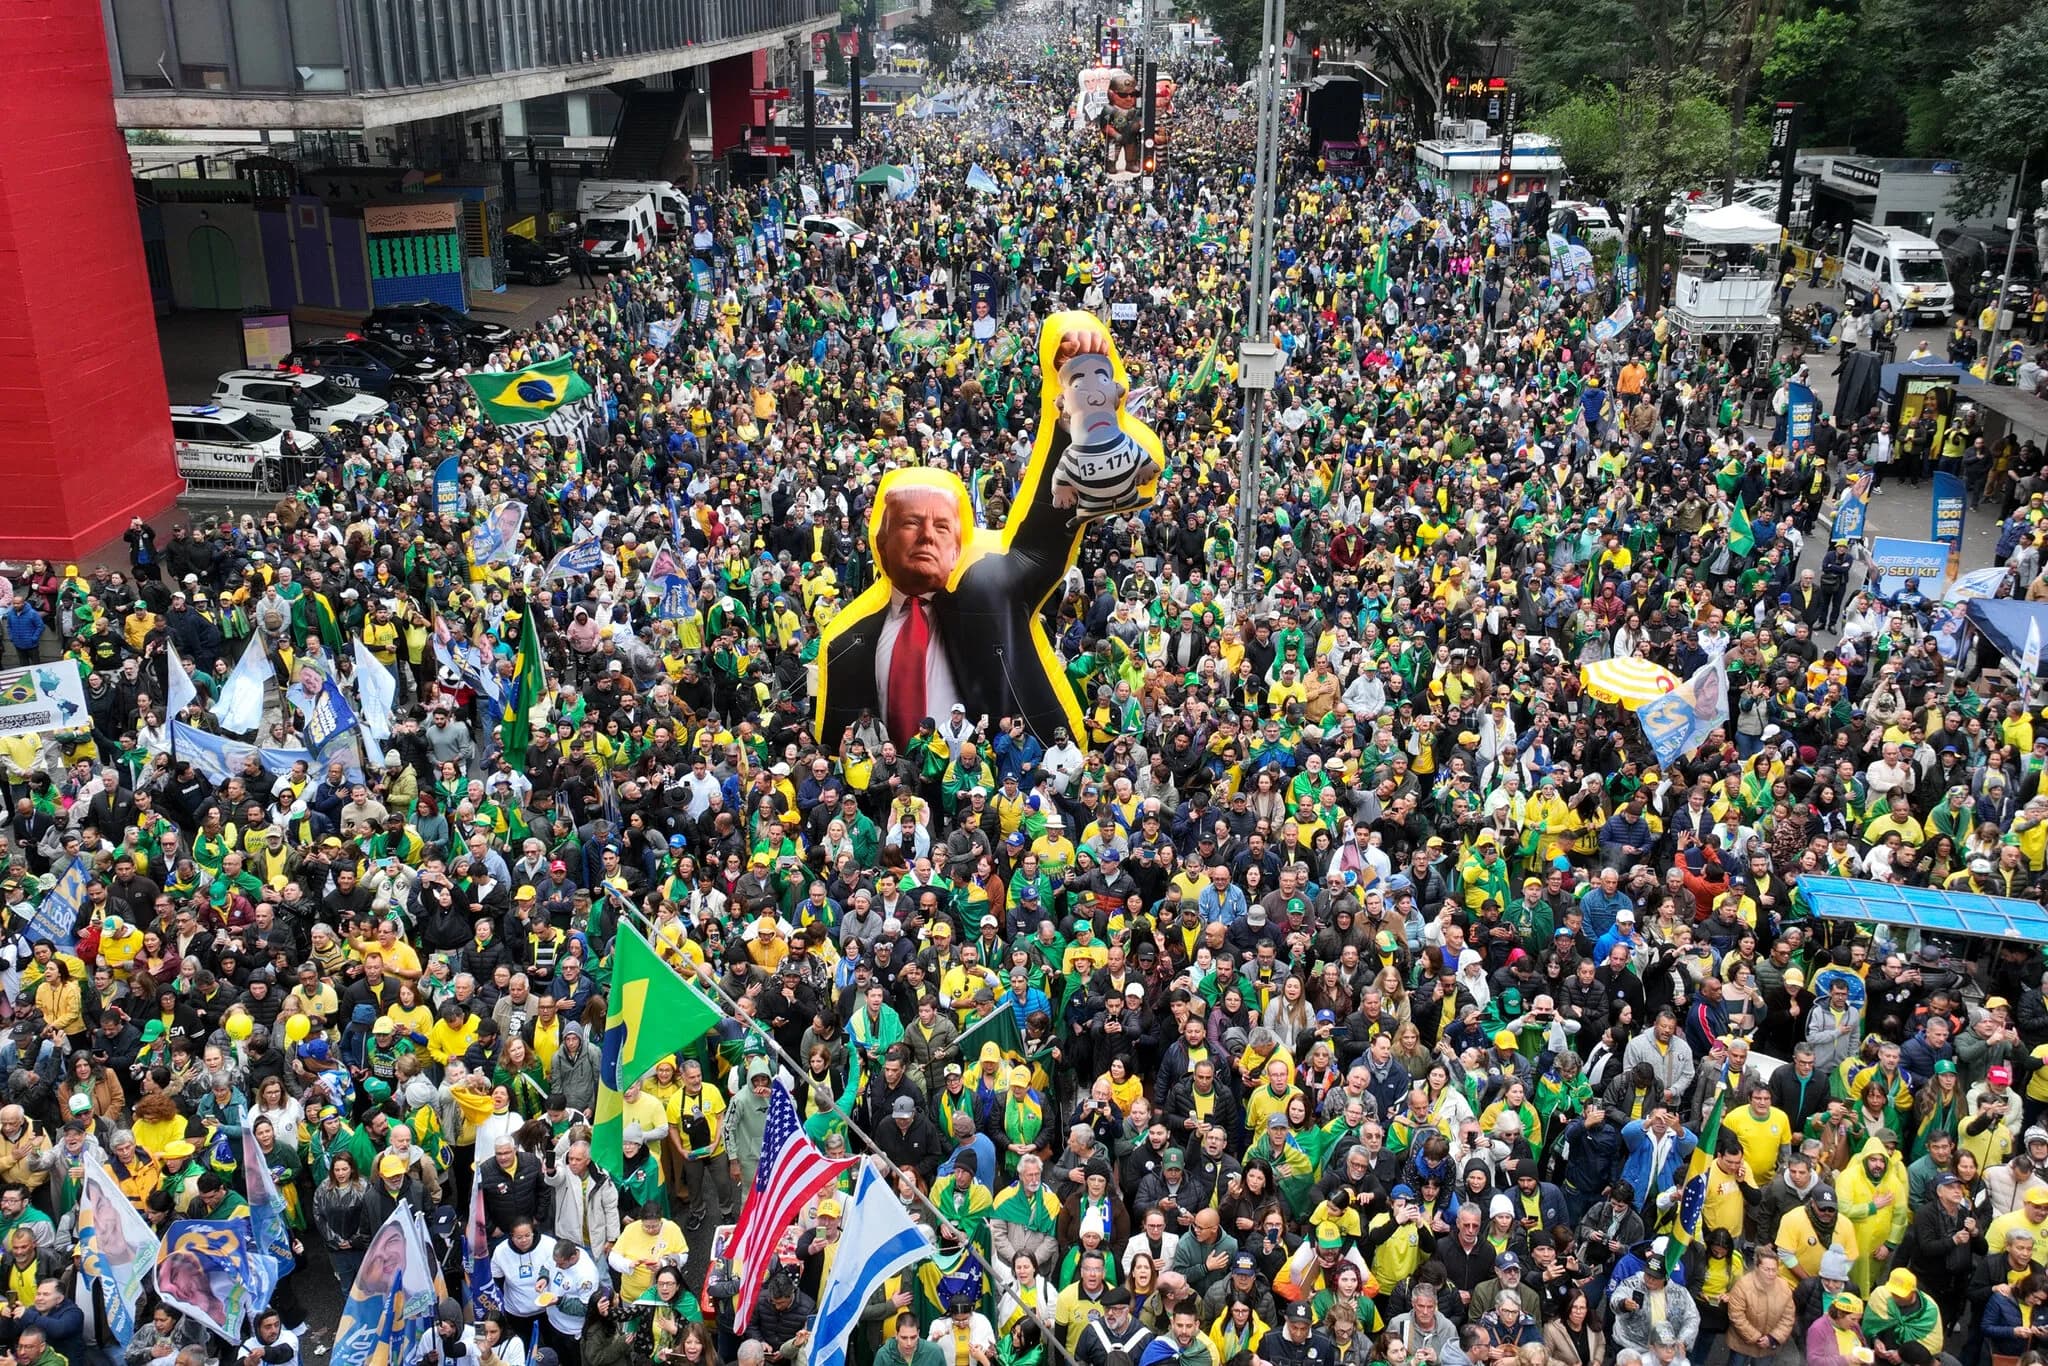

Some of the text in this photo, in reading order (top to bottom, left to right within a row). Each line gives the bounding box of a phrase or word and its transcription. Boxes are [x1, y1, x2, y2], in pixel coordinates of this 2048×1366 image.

[1507, 93, 1516, 119] Branca
[1505, 120, 1513, 141] Casa
[1779, 119, 1790, 147] MILITAR
[1792, 414, 1811, 422] 1001
[213, 452, 246, 463] GCM
[1937, 511, 1961, 519] 1001
[1878, 556, 1942, 566] RETIRE AQUI
[1888, 566, 1916, 577] SEU
[1917, 567, 1940, 577] KIT
